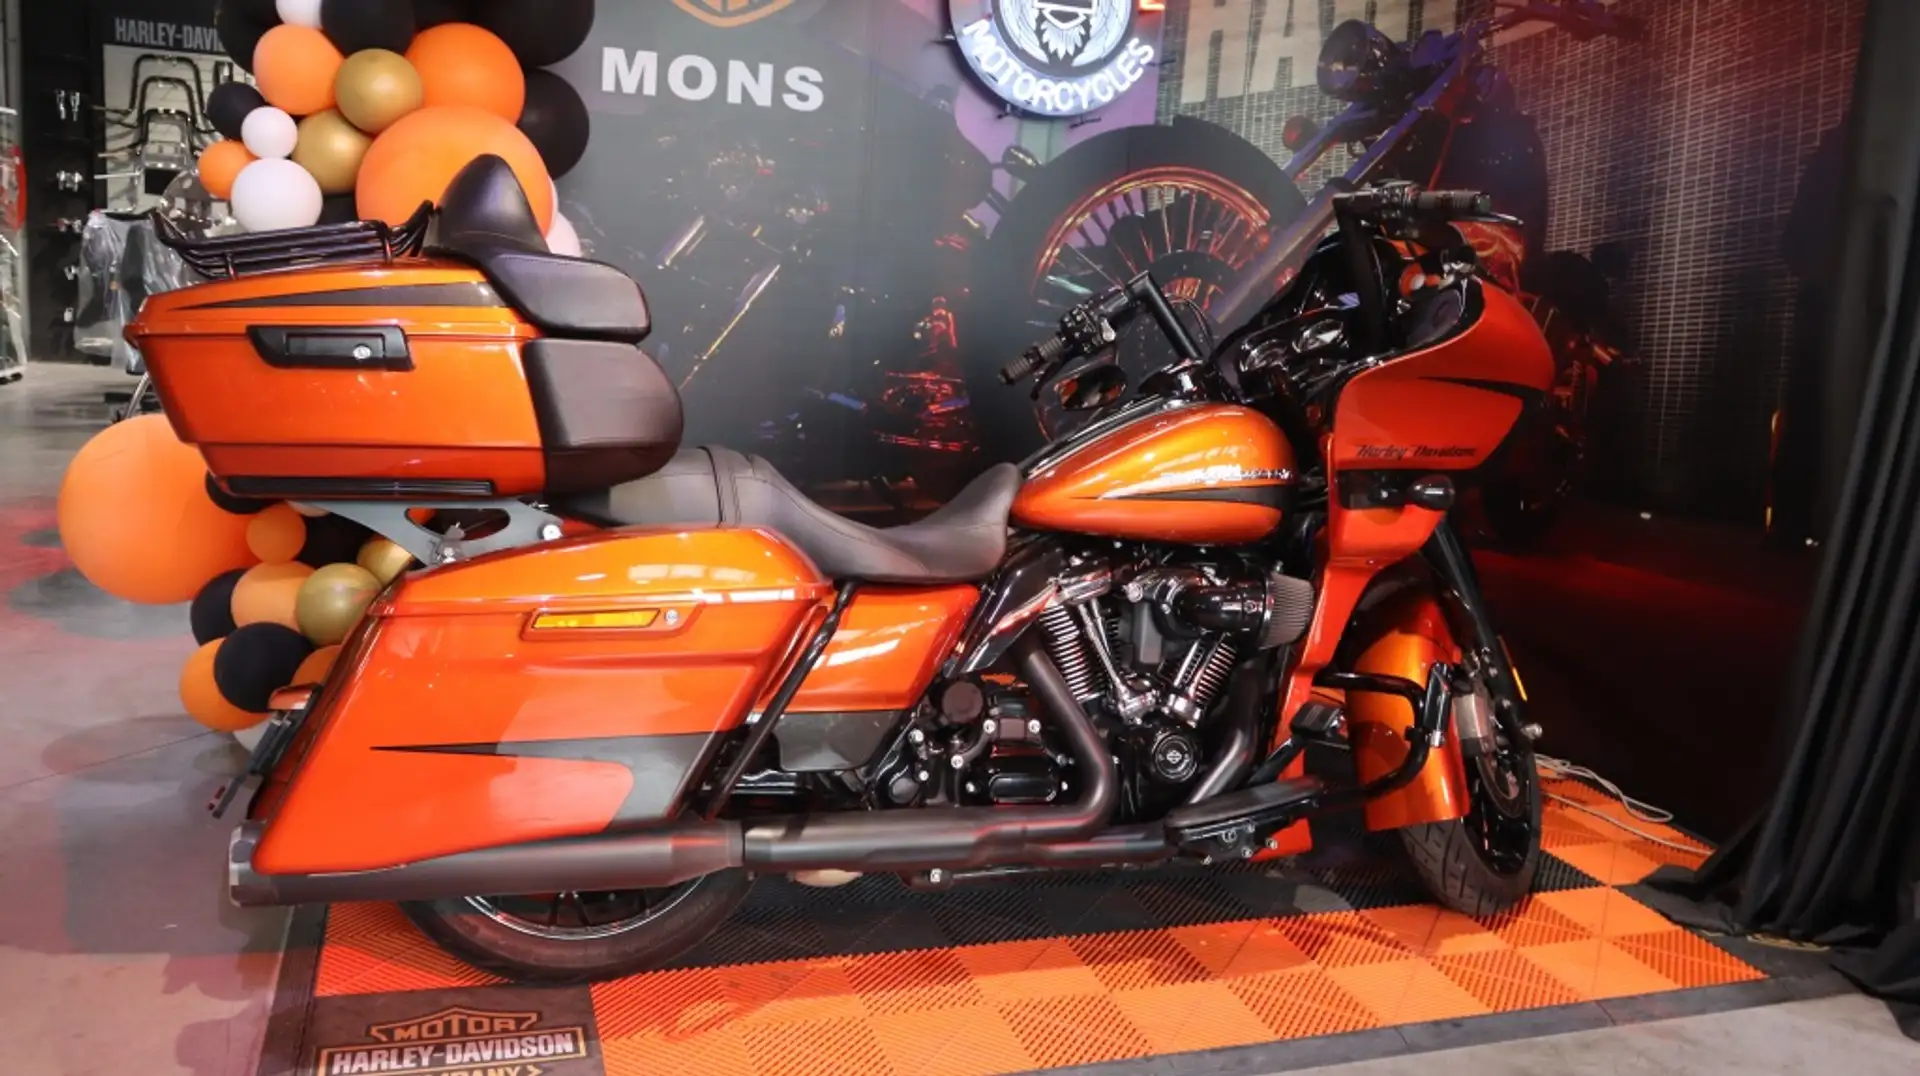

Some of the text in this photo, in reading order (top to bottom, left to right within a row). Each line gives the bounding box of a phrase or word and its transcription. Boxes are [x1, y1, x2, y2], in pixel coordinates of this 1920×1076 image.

[115, 17, 225, 52] HARLEY-DAVI
[601, 46, 824, 112] MONS
[962, 18, 1154, 110] MOTORCYCLES
[393, 1015, 516, 1041] MOTOR
[331, 1032, 574, 1075] HARLEY-DAVIDSON
